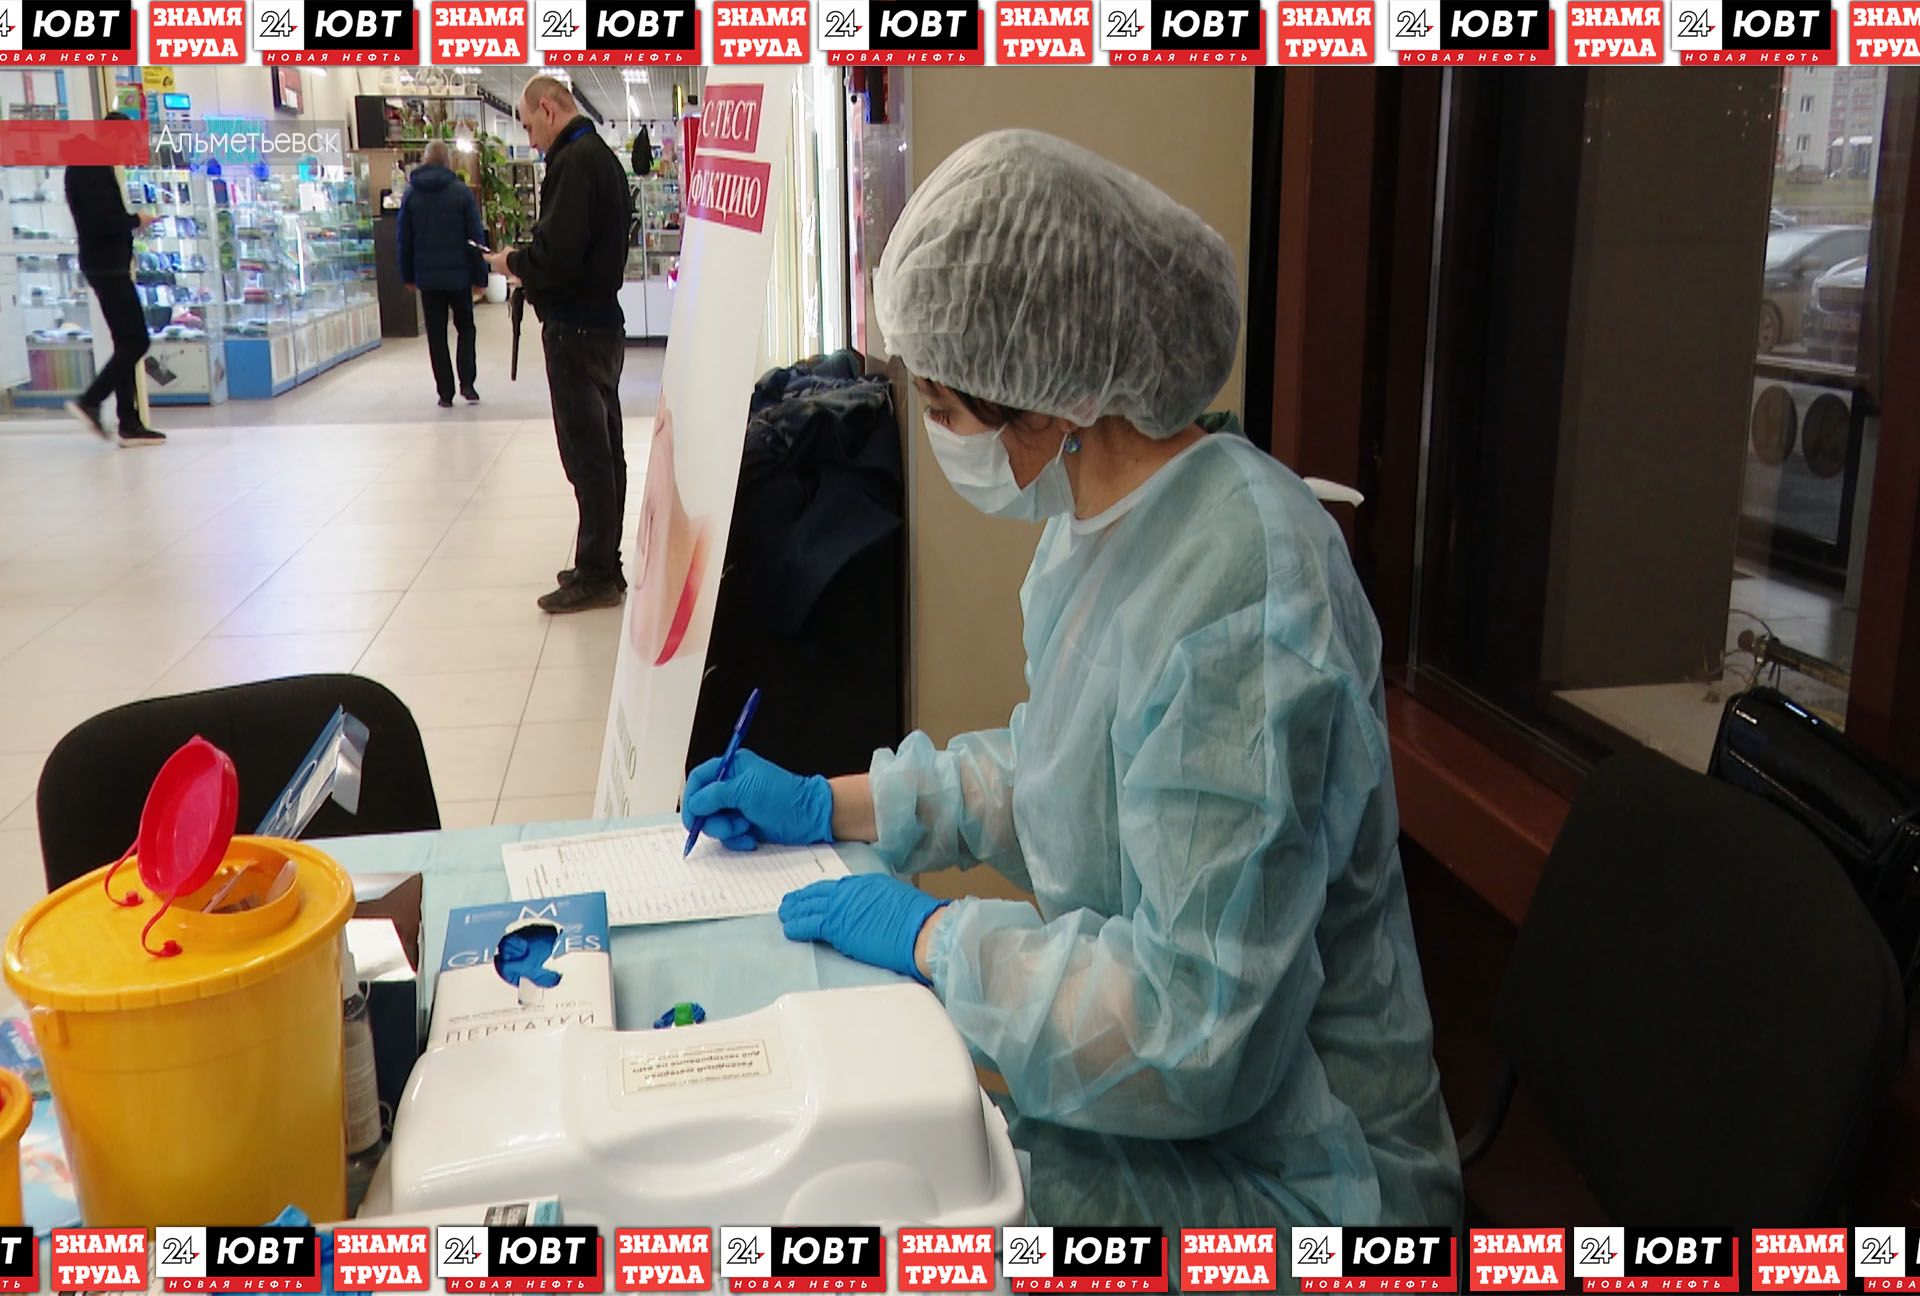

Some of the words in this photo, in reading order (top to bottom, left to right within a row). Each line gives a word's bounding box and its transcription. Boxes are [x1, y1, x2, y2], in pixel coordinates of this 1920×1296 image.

[700, 99, 757, 142] С-ТЕСТ
[447, 934, 602, 968] GLES
[445, 1012, 595, 1044] ПЕРЧАТКИ
